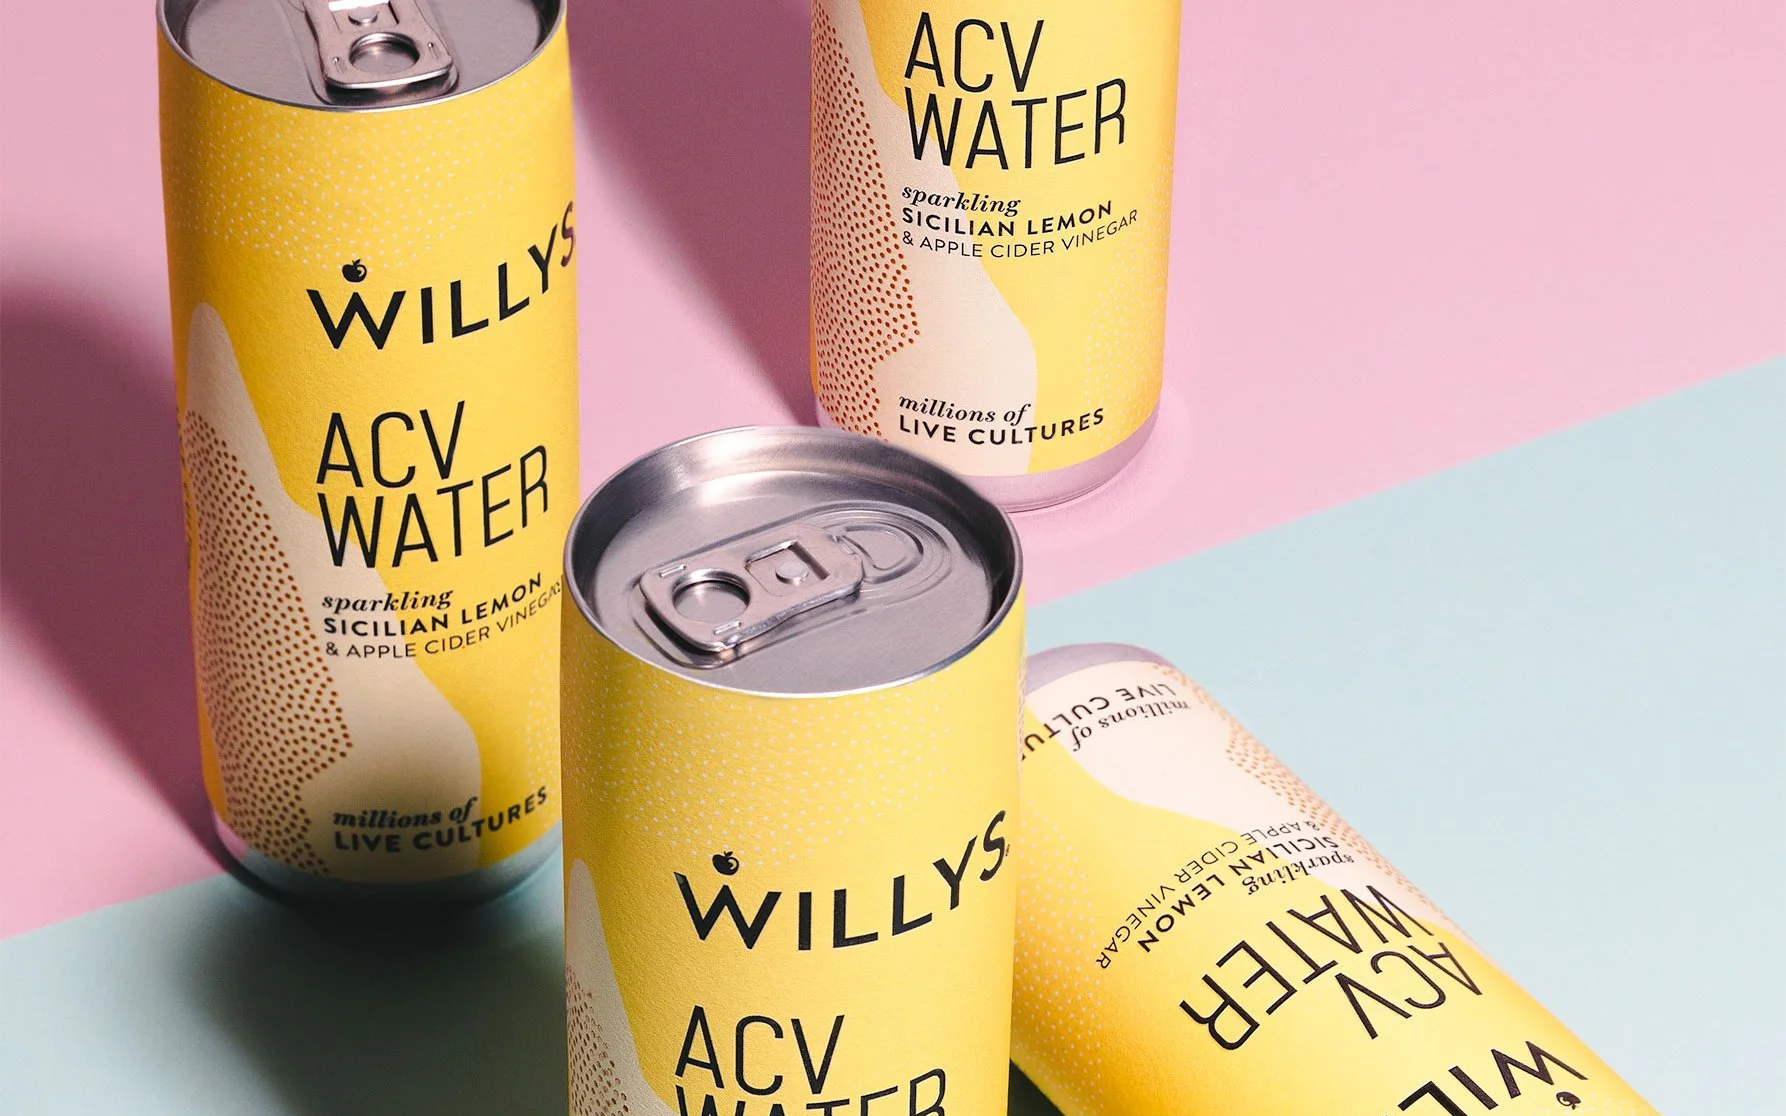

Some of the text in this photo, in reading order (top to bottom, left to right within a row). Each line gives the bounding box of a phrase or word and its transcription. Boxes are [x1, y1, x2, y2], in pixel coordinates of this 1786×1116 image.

[904, 12, 1044, 92] ACV
[904, 78, 1125, 170] WATER
[902, 185, 1021, 218] sparkling
[902, 200, 1112, 237] SICILIAN LEMON
[902, 209, 1138, 258] & APPLE CIDER VINEGAR
[899, 394, 1031, 426] millions of
[900, 408, 1104, 446] LIVE CULTURES
[316, 401, 465, 488] ACV
[317, 445, 549, 568] WATER
[322, 590, 453, 612] sparkling
[324, 572, 541, 637] SICILIAN LEMON
[326, 642, 339, 656] &
[346, 643, 416, 658] APPLE
[425, 626, 490, 654] CIDER
[1021, 683, 1177, 761] LIVE CULTU
[1072, 700, 1191, 752] millions of
[333, 797, 477, 829] millions of
[335, 786, 547, 851] LIVE CULTURES
[1240, 821, 1303, 845] APPLE
[1174, 840, 1239, 884] CIDER
[1242, 851, 1355, 895] sparkling
[1137, 836, 1339, 953] SICILIAN LEMON
[1096, 884, 1175, 969] VINEGAR
[1179, 885, 1435, 1050] WATER
[1336, 942, 1483, 1040] ACV
[675, 1005, 845, 1096] ACV
